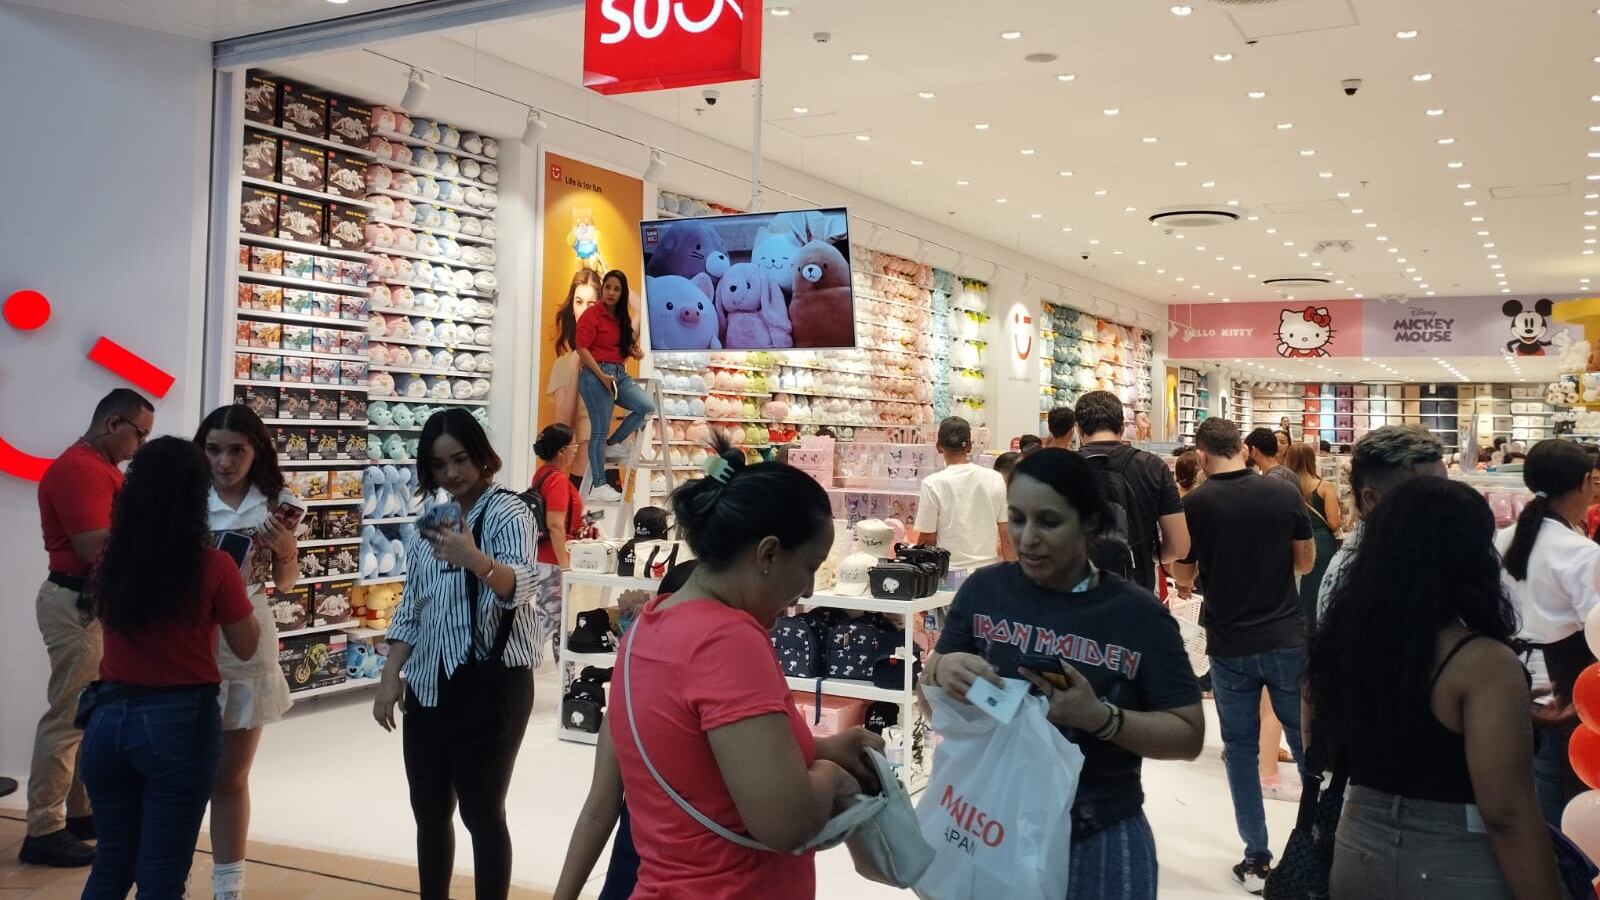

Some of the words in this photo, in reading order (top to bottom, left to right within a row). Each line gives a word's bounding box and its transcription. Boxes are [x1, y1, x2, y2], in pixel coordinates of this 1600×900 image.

[565, 176, 576, 186] Life
[583, 181, 592, 190] for
[1408, 306, 1438, 318] Disney
[1392, 318, 1454, 330] MICKEY
[1221, 327, 1253, 337] KITTY
[1394, 330, 1452, 342] MOUSE
[972, 613, 1033, 654] IRON
[1034, 626, 1142, 681] MAIDEN
[940, 784, 1005, 848] MNISO
